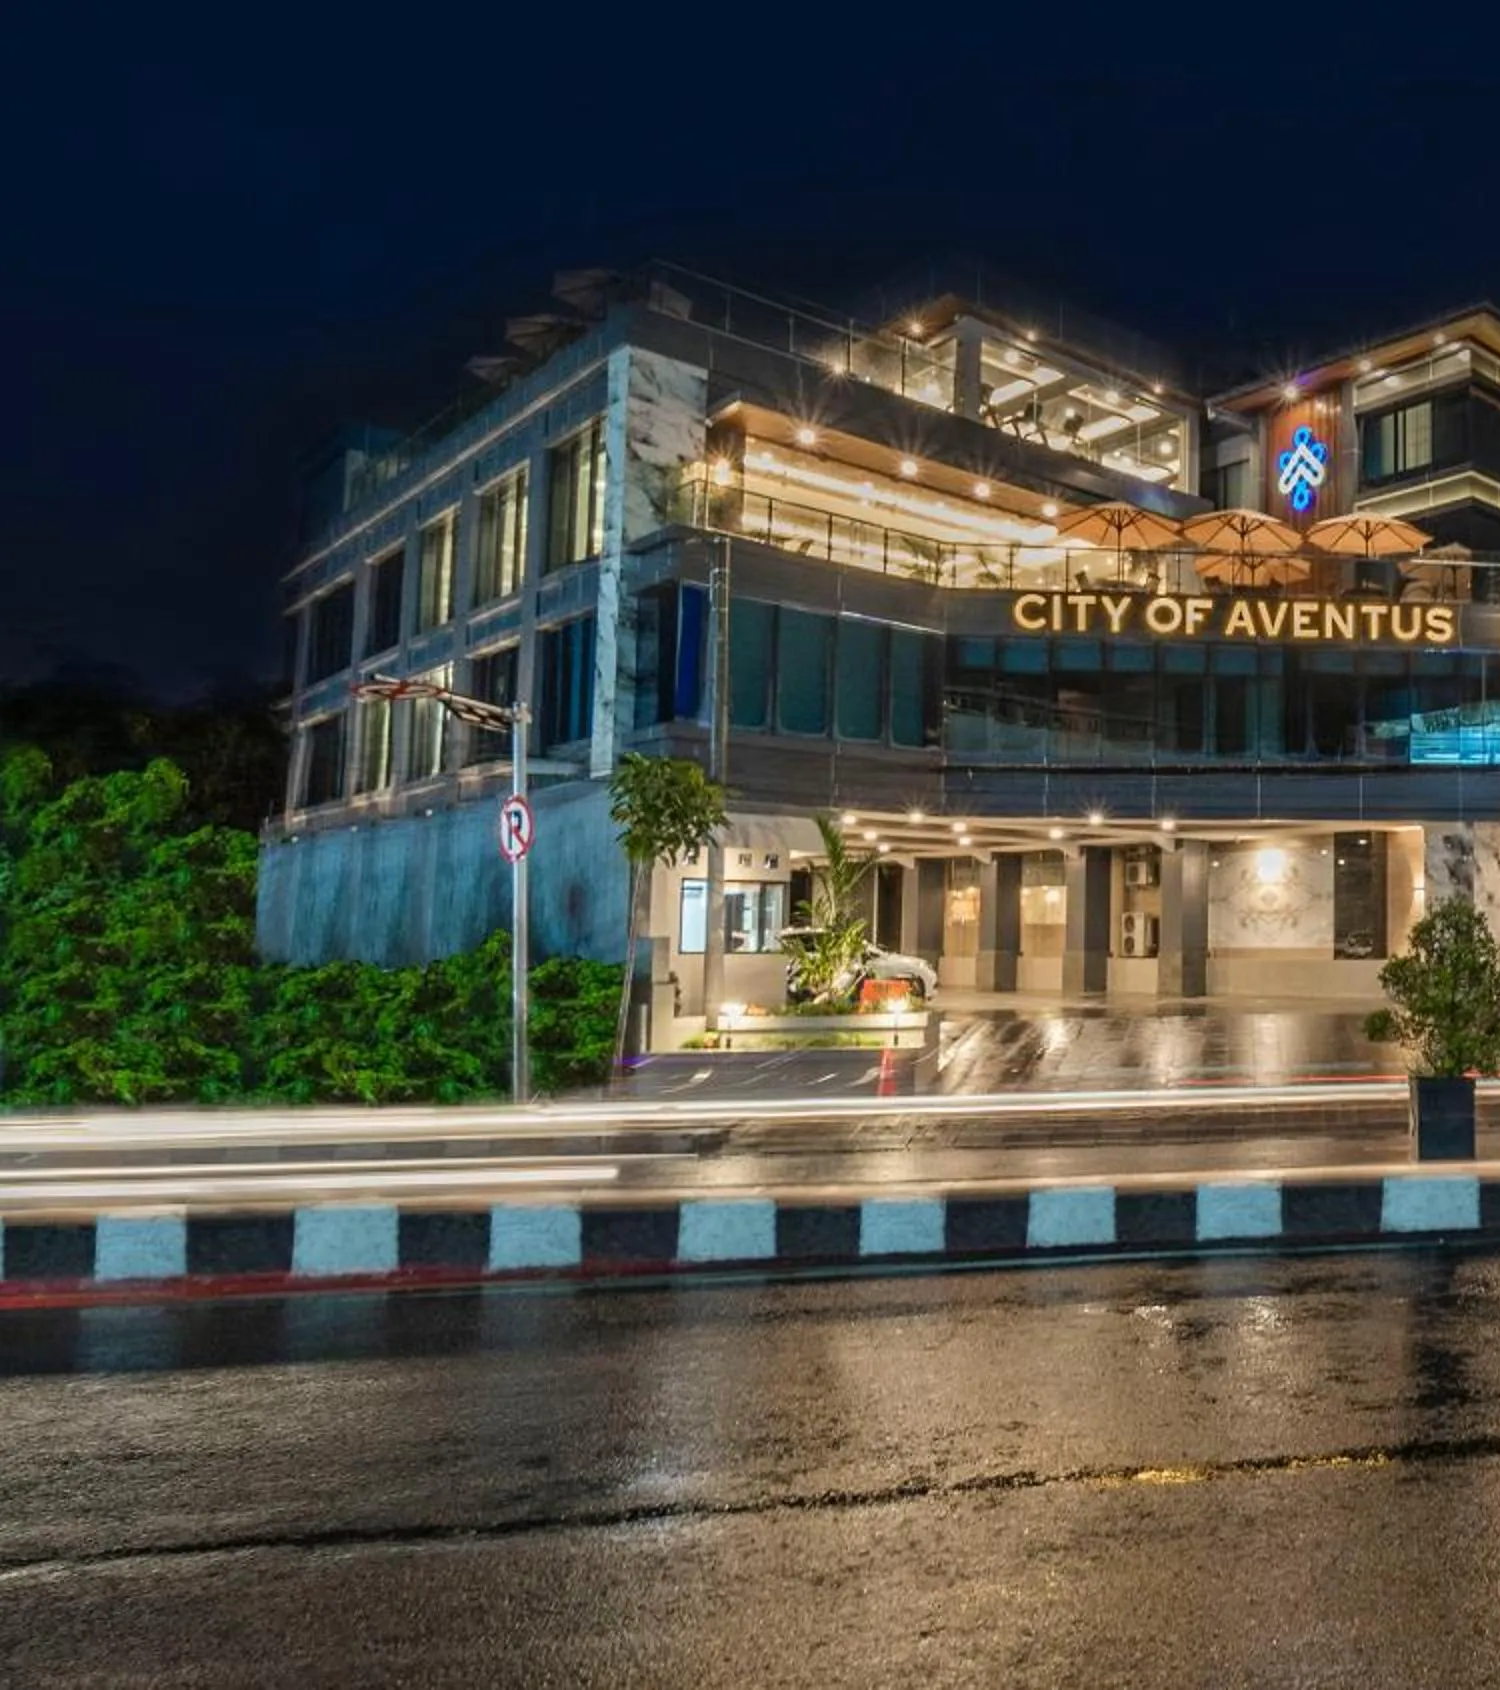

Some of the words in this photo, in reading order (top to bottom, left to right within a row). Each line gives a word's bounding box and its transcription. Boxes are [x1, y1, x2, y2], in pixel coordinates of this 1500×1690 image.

[1014, 593, 1132, 633] CITY
[1146, 598, 1213, 635] OF
[1225, 600, 1453, 642] AVENTUS
